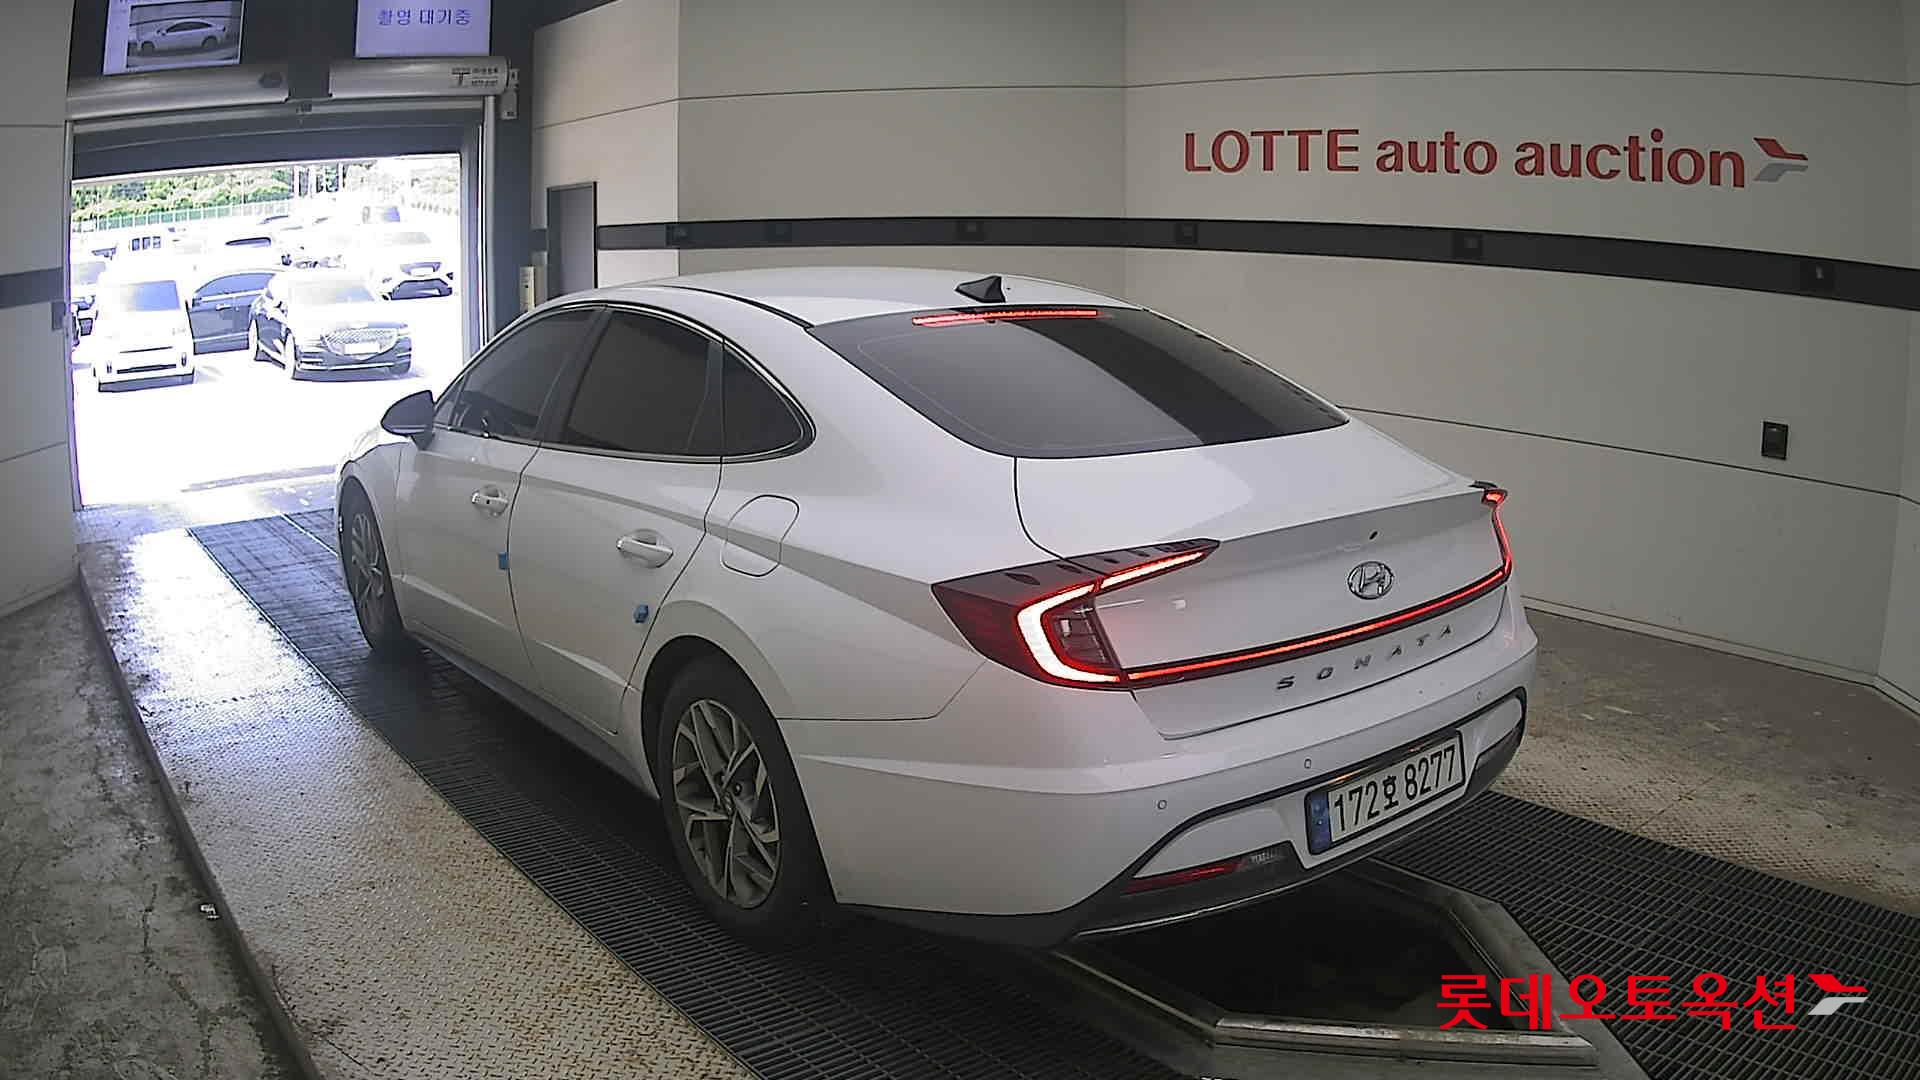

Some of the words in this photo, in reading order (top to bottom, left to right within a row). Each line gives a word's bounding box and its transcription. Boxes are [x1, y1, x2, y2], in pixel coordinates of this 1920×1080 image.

[419, 9, 471, 26] 대기중
[1185, 129, 1360, 173] LOTTE
[1375, 130, 1498, 175] auto
[1514, 128, 1746, 188] auction
[1276, 623, 1453, 691] SONATA
[1334, 775, 1400, 832] 172호
[1404, 744, 1456, 800] 8277
